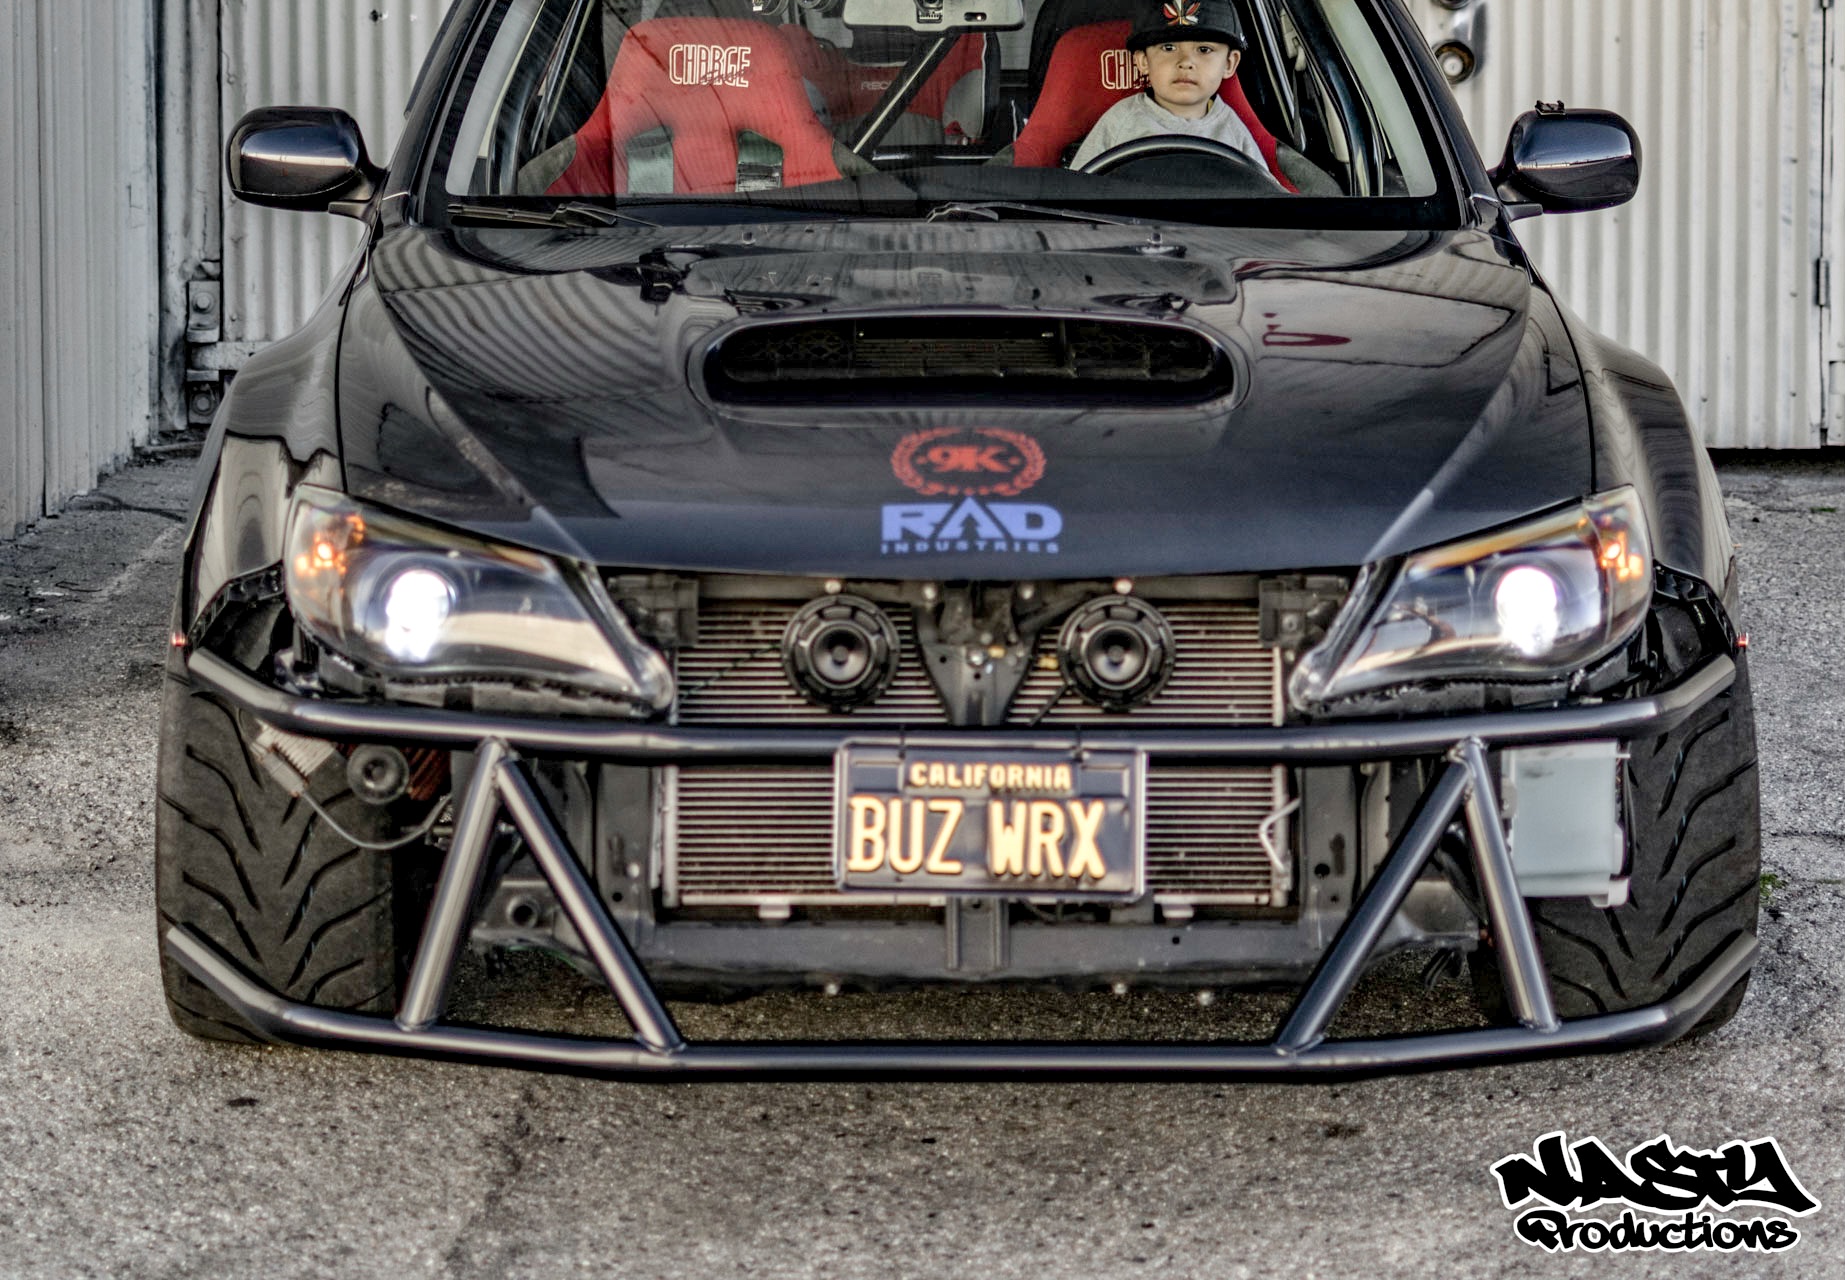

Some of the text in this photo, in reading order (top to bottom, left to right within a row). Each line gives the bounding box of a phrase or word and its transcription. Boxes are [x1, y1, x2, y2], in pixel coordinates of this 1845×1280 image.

[669, 44, 752, 88] CHARGE
[881, 496, 1063, 540] RAD
[881, 541, 1060, 555] INDUSTRIES
[909, 762, 1073, 791] CALIFORNIA
[847, 793, 1107, 880] BUZ WRX
